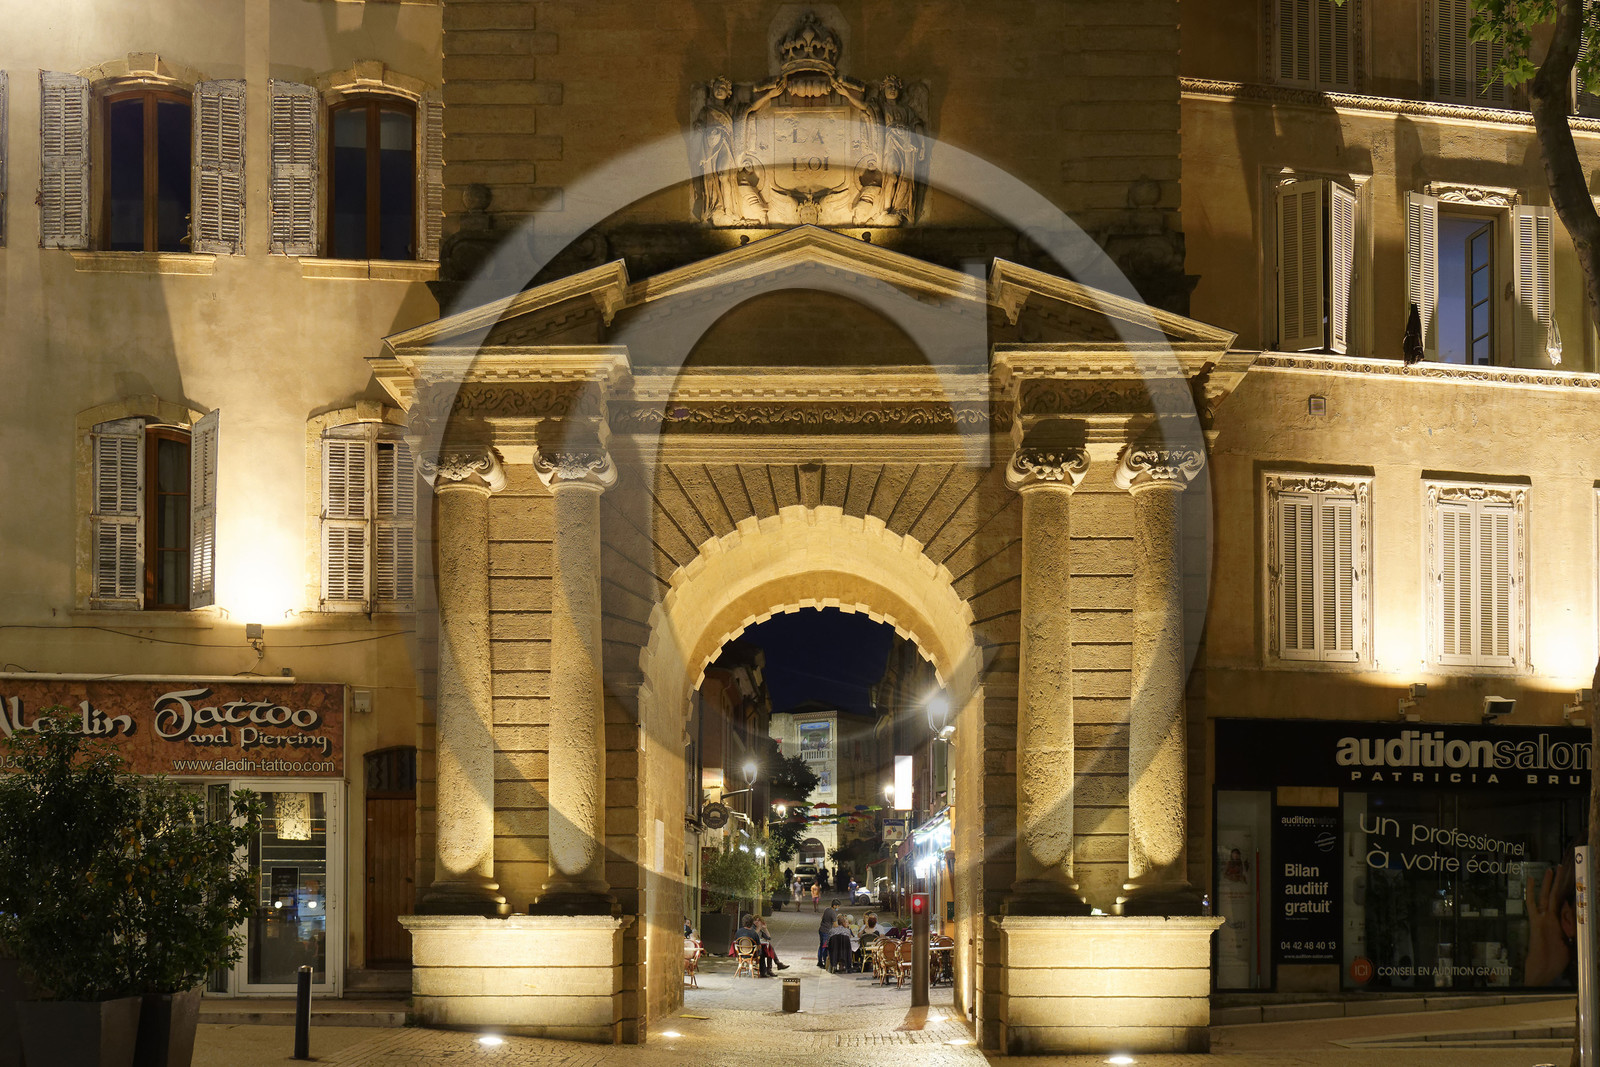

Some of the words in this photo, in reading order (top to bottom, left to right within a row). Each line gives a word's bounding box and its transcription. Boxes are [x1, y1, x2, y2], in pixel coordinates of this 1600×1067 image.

[792, 129, 825, 144] LA
[791, 156, 829, 172] LOI
[153, 688, 318, 738] Tattoo
[188, 727, 228, 743] and
[240, 727, 327, 754] Piercing
[173, 758, 335, 772] www.aladin-tattoo.com
[1351, 771, 1500, 784] PATRICIA
[1527, 774, 1580, 785] BRU
[1360, 813, 1400, 838] un
[1411, 823, 1525, 856] professionnel
[1366, 843, 1390, 869] à
[1401, 851, 1460, 872] votre
[1285, 864, 1320, 877] Bilan
[1285, 882, 1329, 895] auditif
[1280, 941, 1290, 950] 04
[1292, 941, 1302, 950] 42
[1304, 941, 1314, 950] 48
[1315, 941, 1325, 950] 40
[1328, 941, 1336, 950] 13
[1354, 964, 1369, 977] ICI
[1377, 966, 1416, 976] CONSEIL
[1418, 966, 1430, 976] EN
[1431, 966, 1474, 976] AUDITION
[1475, 966, 1513, 976] GRATUIT
